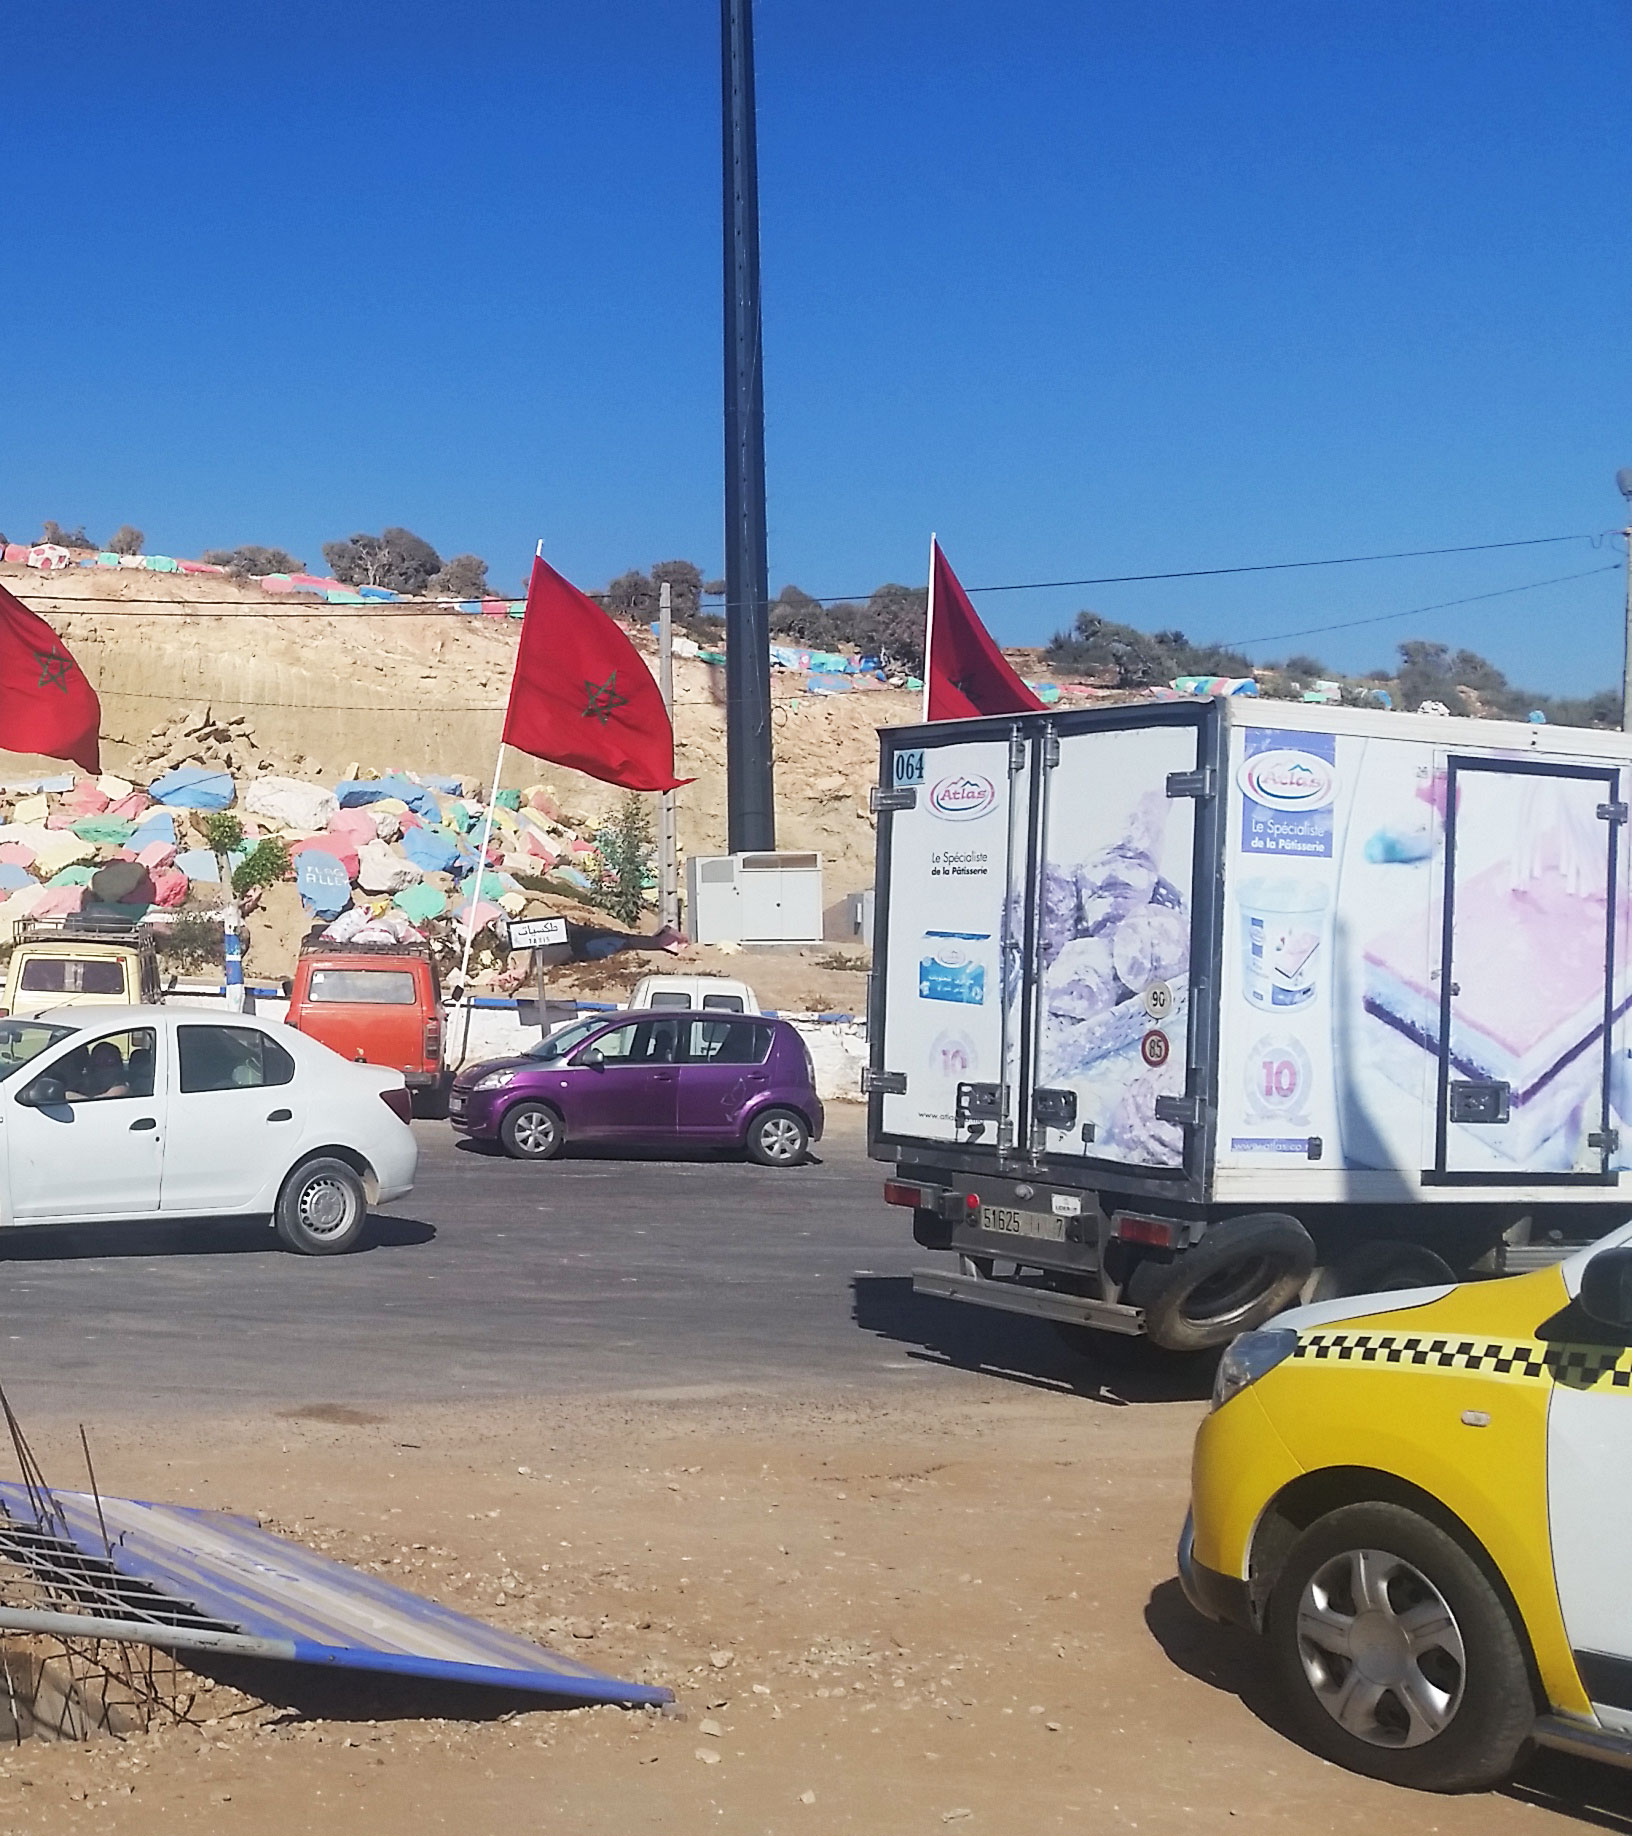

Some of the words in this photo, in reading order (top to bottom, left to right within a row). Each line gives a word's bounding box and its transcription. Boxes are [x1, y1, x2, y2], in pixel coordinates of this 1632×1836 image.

[896, 751, 925, 780] 064
[1260, 771, 1321, 788] Atlas
[940, 788, 987, 801] Atlas
[1252, 818, 1264, 833] Le
[1267, 819, 1325, 838] Spécialiste
[1251, 837, 1265, 848] de
[1267, 838, 1276, 849] la
[1279, 838, 1325, 852] Pâtisserie
[932, 852, 941, 864] Le
[943, 851, 988, 865] Spécialiste
[931, 867, 941, 876] de
[942, 867, 950, 876] la
[951, 867, 988, 876] Pâtisserie
[518, 922, 558, 937] طكسيات
[1152, 991, 1165, 1007] 90
[1149, 1039, 1163, 1058] 85
[941, 1049, 967, 1077] 10
[1262, 1060, 1296, 1098] 10
[984, 1208, 1020, 1233] 51625
[1056, 1219, 1063, 1238] 7
